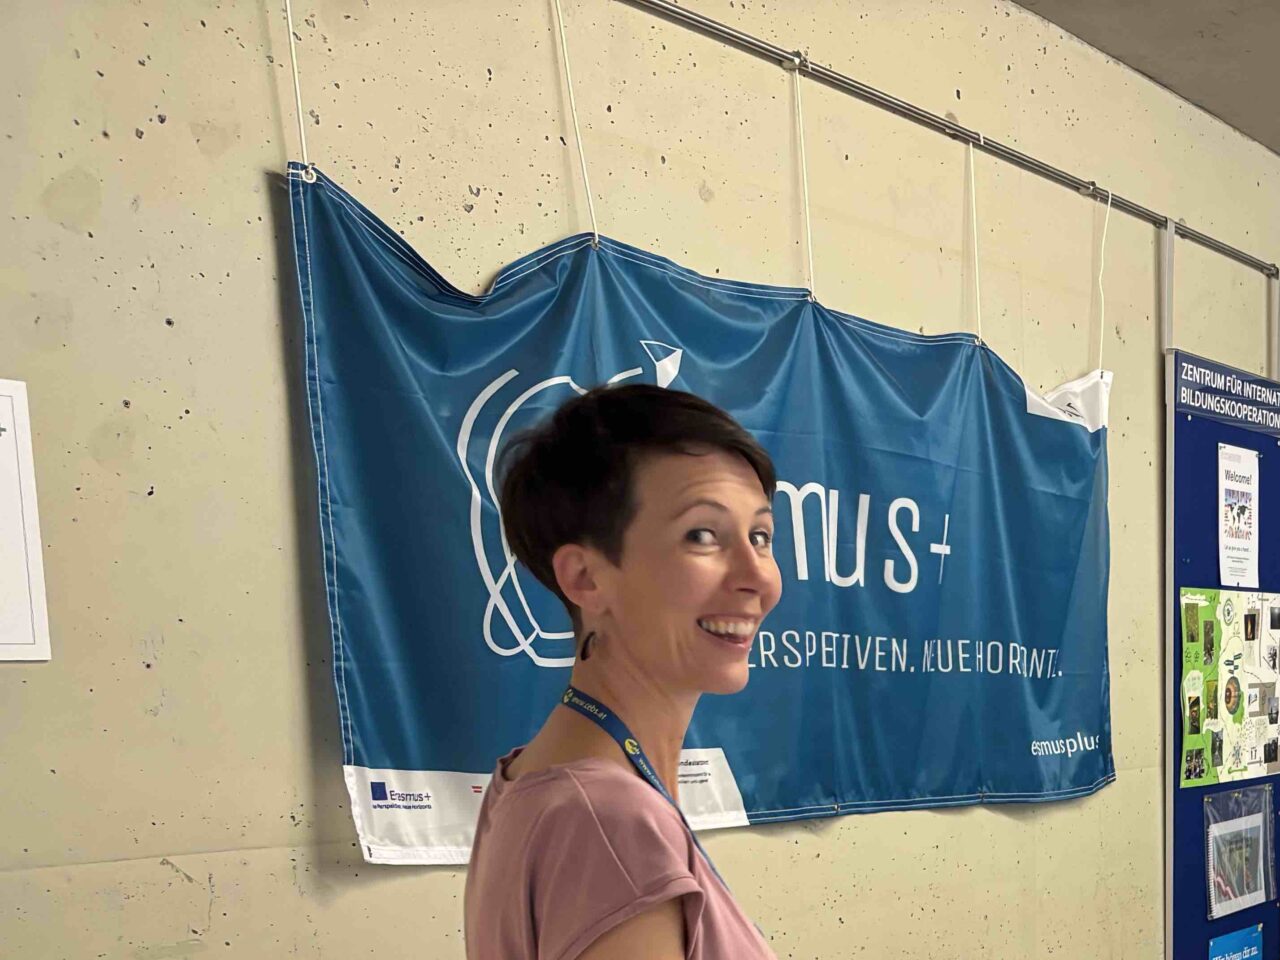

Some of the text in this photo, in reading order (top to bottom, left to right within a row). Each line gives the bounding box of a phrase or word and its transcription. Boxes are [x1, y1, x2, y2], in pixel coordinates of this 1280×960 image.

[1181, 362, 1225, 390] ZENTRUM
[1226, 374, 1242, 395] FÜR
[1224, 469, 1252, 485] Welcome!
[776, 479, 950, 593] mus+
